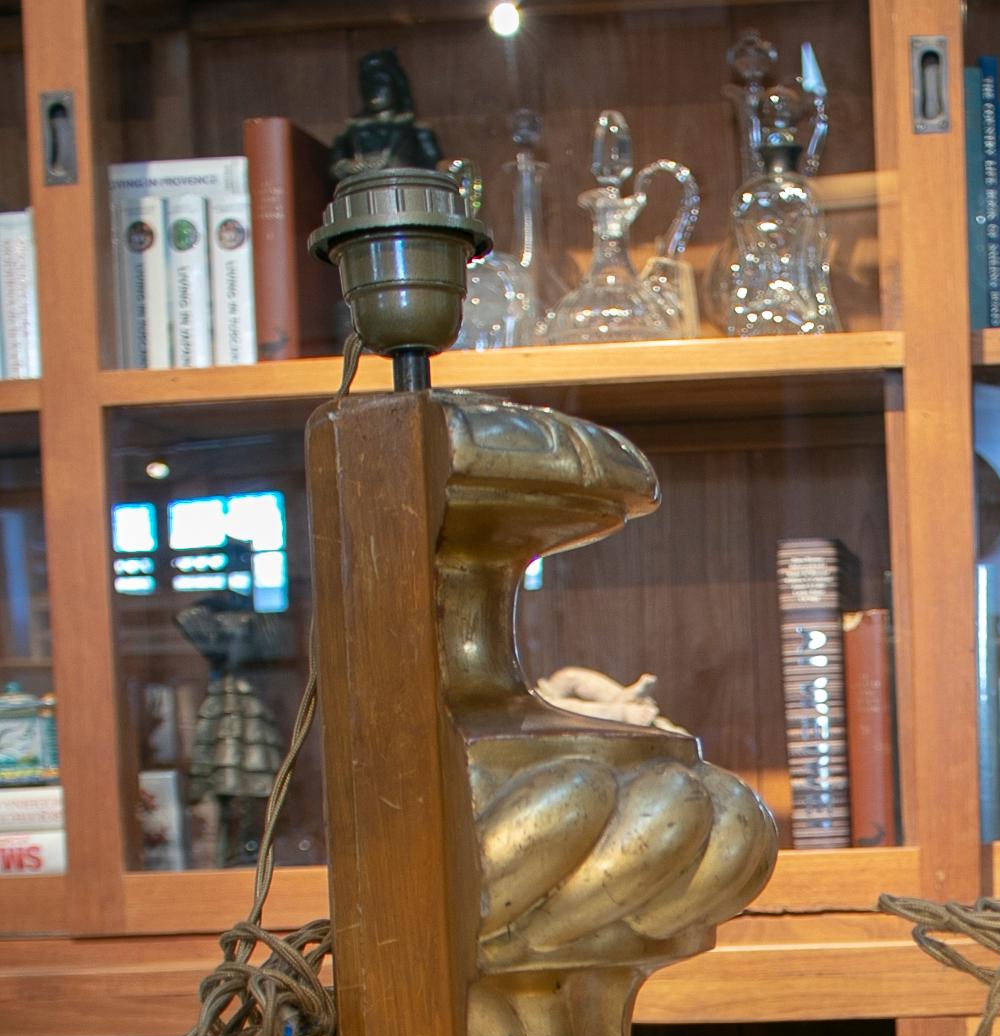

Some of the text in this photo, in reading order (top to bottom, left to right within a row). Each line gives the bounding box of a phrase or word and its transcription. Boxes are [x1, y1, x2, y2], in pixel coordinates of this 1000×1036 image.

[983, 102, 996, 155] COUNTRY
[159, 174, 218, 186] PROVENCE
[177, 266, 191, 308] LIVING
[225, 260, 239, 298] LIVING
[179, 312, 191, 326] IN
[227, 302, 239, 316] IN
